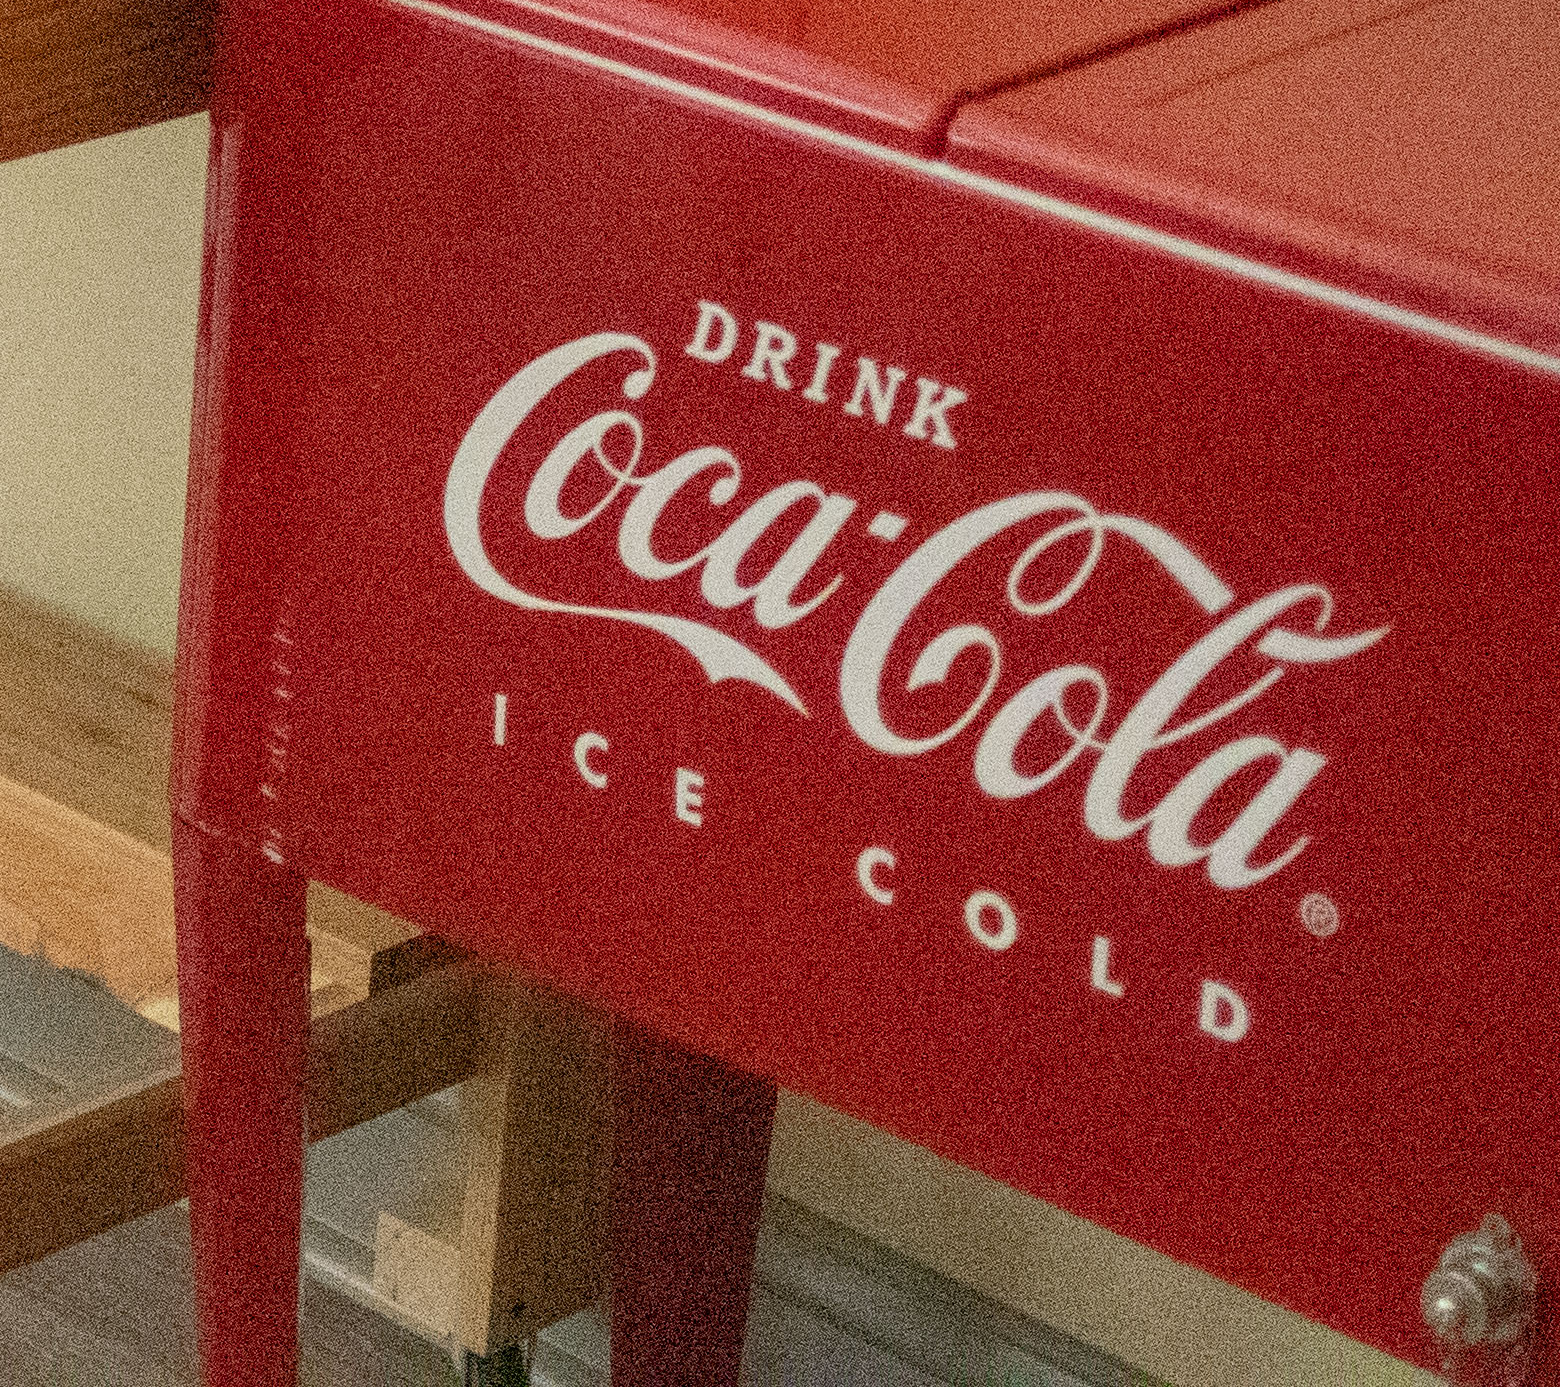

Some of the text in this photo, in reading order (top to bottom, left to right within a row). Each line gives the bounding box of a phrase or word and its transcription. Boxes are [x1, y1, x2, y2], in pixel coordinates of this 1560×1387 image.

[686, 301, 968, 449] DRINK
[444, 331, 1392, 889] Coca-Cola
[494, 694, 1250, 1043] ICE COLD
